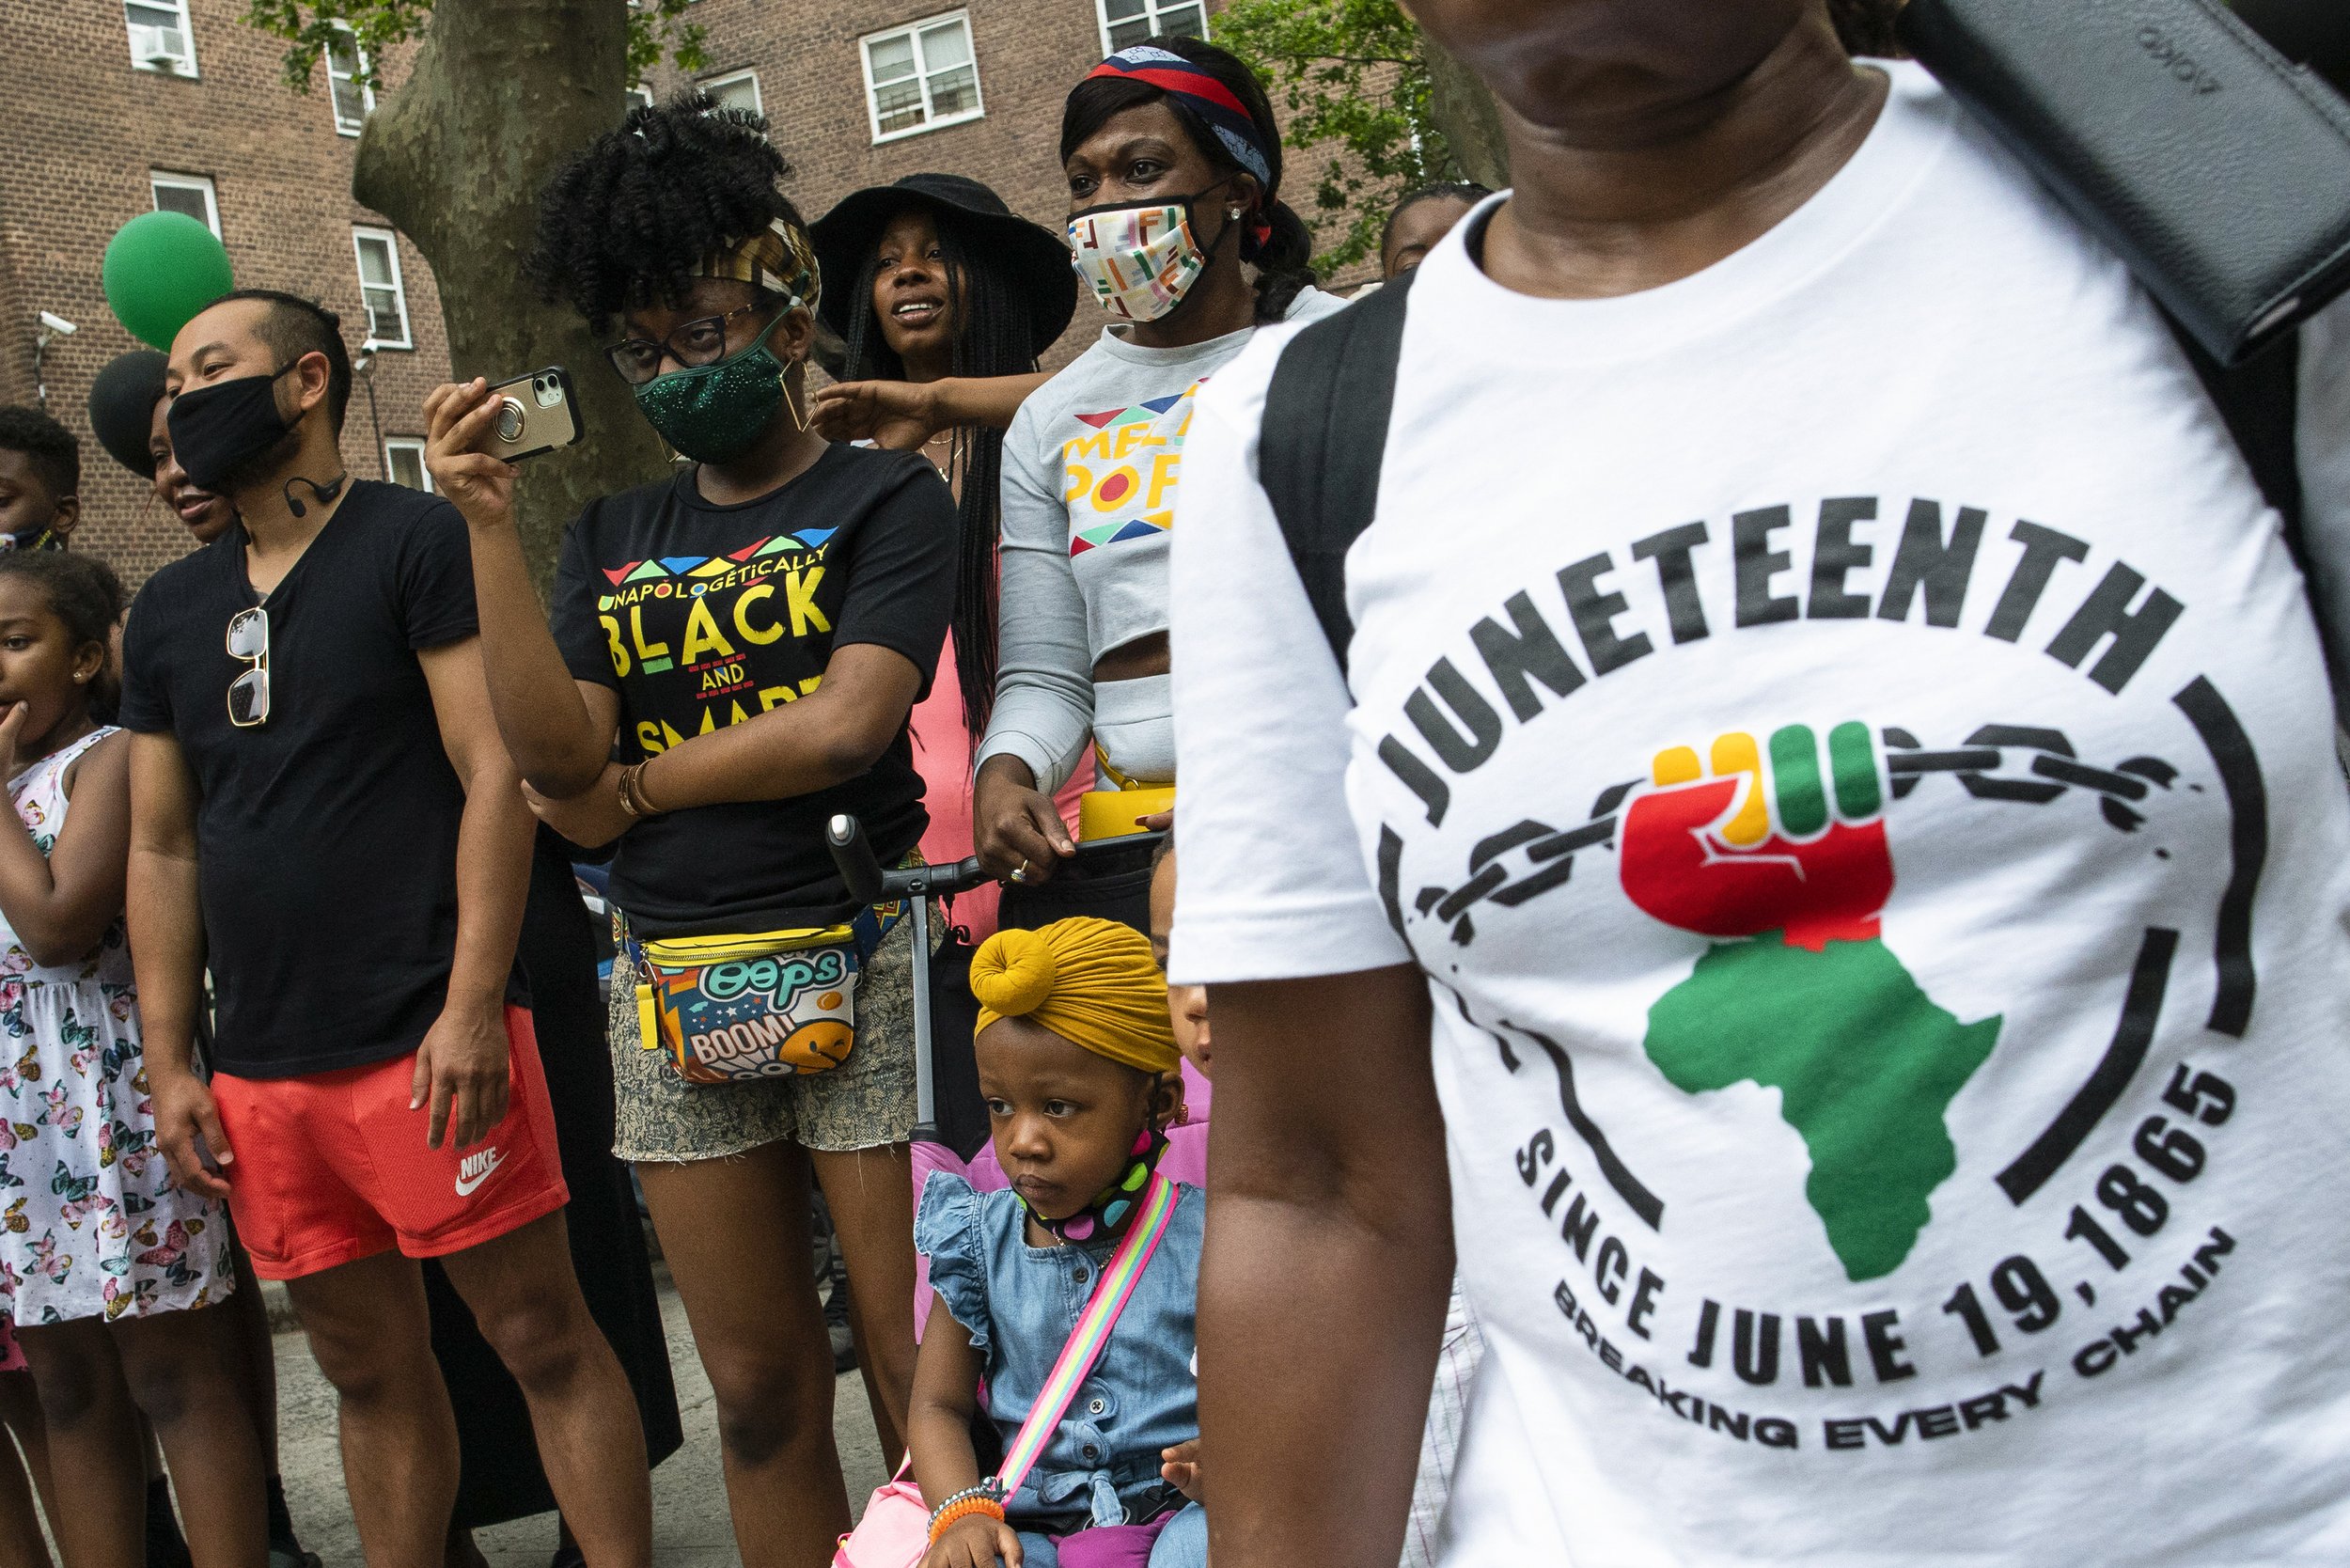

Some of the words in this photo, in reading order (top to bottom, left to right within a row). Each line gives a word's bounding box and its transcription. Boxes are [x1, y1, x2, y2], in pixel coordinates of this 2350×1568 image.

[598, 566, 833, 678] BLACK
[701, 663, 745, 691] AND
[1377, 495, 2186, 828] JUNETEENTH
[460, 1146, 496, 1180] NIKE
[1516, 1128, 1665, 1341] SINCE
[1687, 1297, 1917, 1388] JUNE
[1552, 1279, 1799, 1450] BREAKING
[1824, 1371, 2046, 1450] EVERY
[2073, 1226, 2238, 1378] CHAIN
